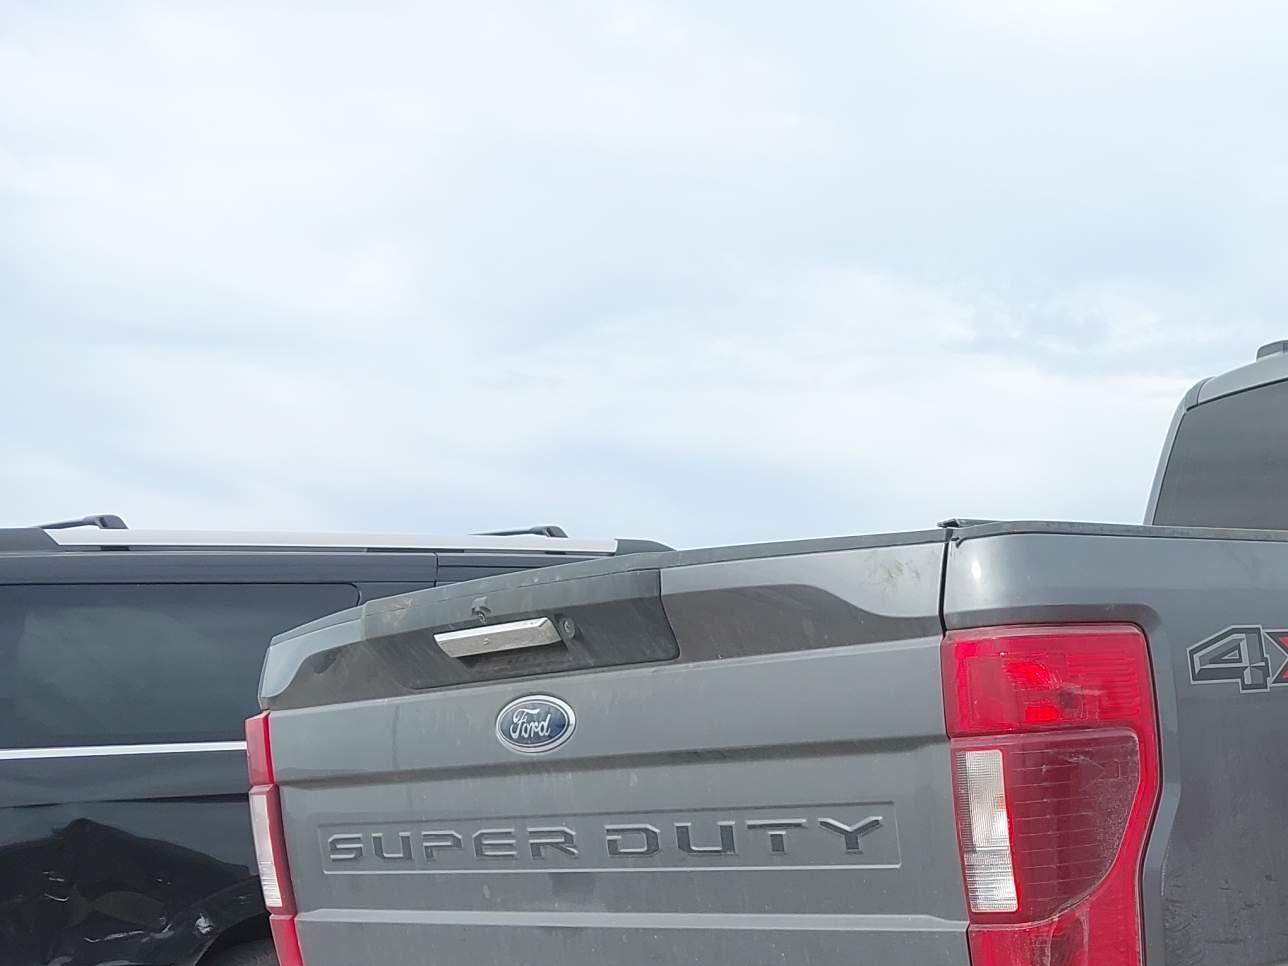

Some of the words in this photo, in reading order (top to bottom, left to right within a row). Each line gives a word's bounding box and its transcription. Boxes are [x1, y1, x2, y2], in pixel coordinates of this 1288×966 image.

[509, 707, 552, 739] Ford
[327, 826, 579, 862] SUPER
[603, 815, 883, 857] DUTY
